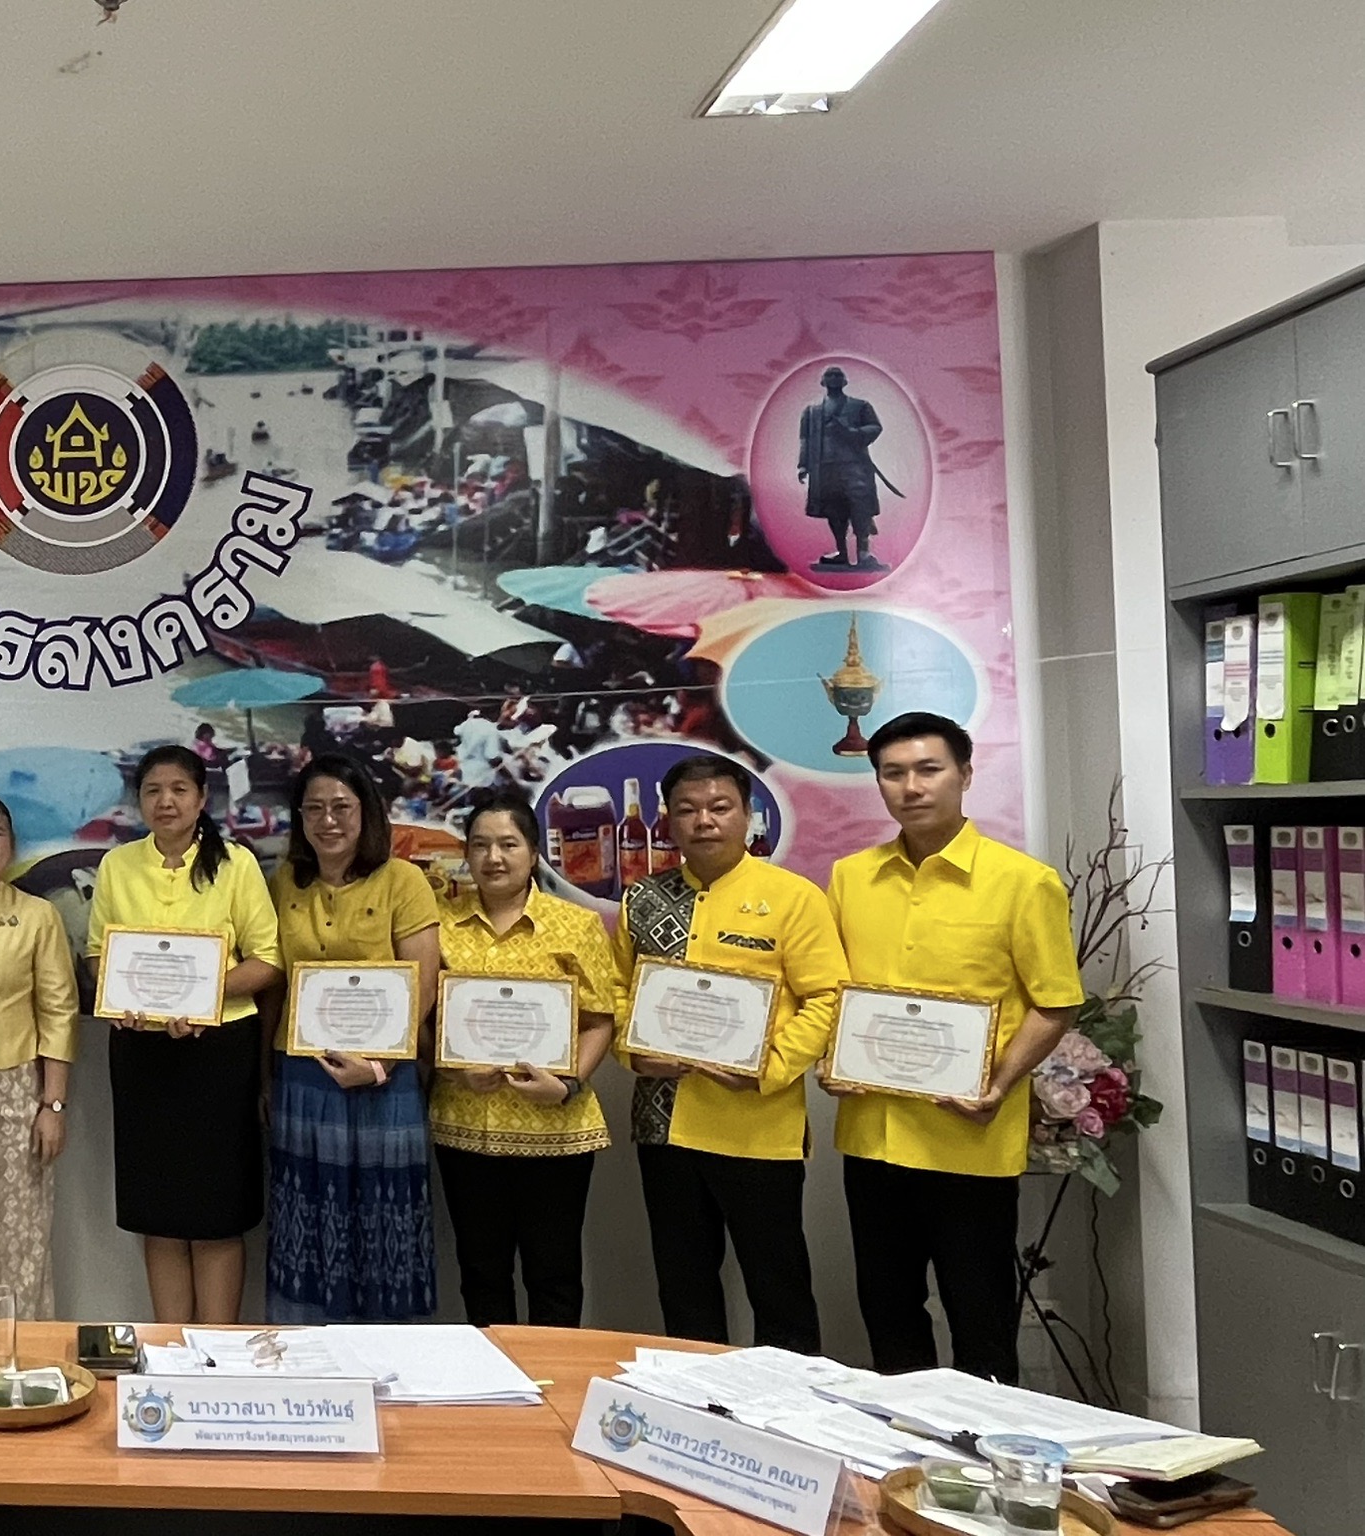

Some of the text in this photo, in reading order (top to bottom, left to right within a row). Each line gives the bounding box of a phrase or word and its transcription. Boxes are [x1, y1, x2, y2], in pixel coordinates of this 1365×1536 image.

[187, 1400, 276, 1416] นางวาสนา
[644, 1421, 819, 1494] นางสาวสุรีวรรณ คณนา
